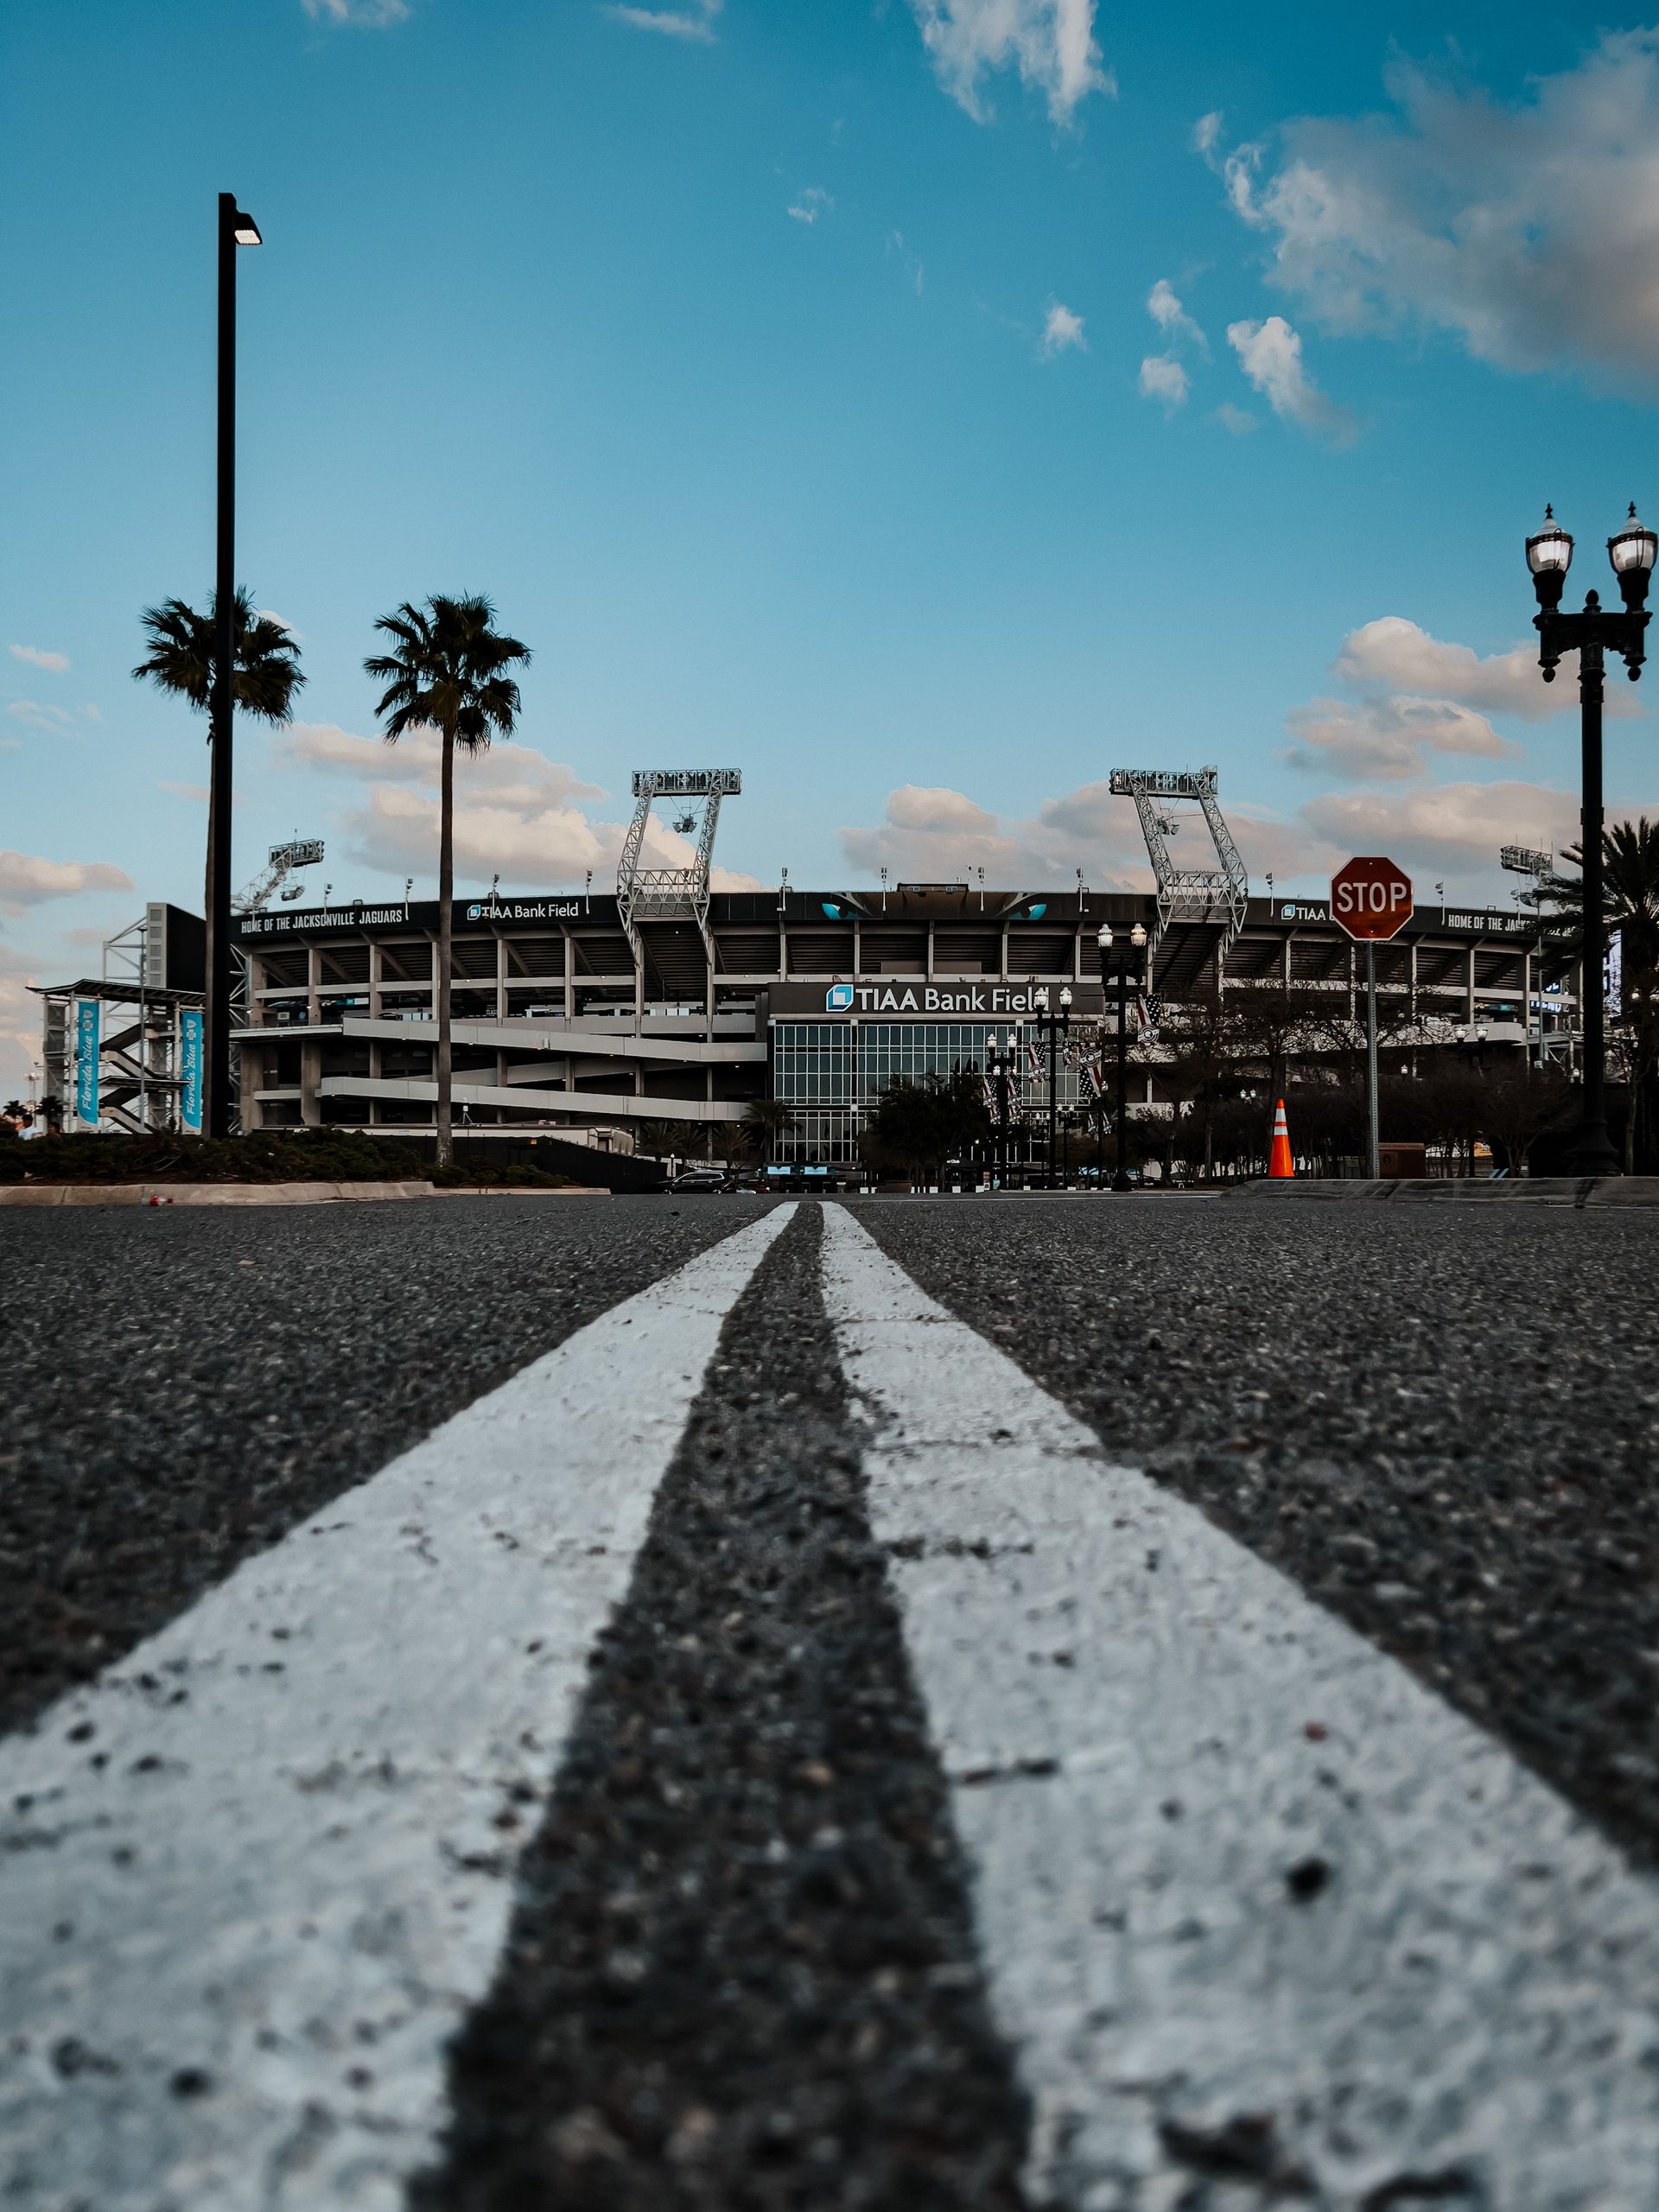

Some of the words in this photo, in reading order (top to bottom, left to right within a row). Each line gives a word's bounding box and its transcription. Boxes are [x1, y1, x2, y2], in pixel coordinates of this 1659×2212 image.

[1337, 881, 1407, 912] STOP
[241, 918, 262, 934] HOME
[264, 918, 273, 931] OF
[276, 917, 290, 931] THE
[292, 912, 355, 929] JACKSONVILLE
[359, 909, 403, 925] JAGUARS
[481, 905, 512, 919] TIAA
[514, 903, 545, 918] Bank
[548, 902, 579, 918] Field
[1296, 906, 1326, 921] TIAA
[1448, 914, 1472, 929] HOME
[1473, 915, 1484, 930] OF
[1487, 917, 1503, 931] THE
[855, 988, 919, 1011] TIAA
[925, 986, 986, 1012] Bank
[83, 1035, 93, 1062] Blue
[186, 1044, 197, 1069] Blue
[81, 1063, 93, 1110] Florida
[186, 1071, 197, 1115] Florida
